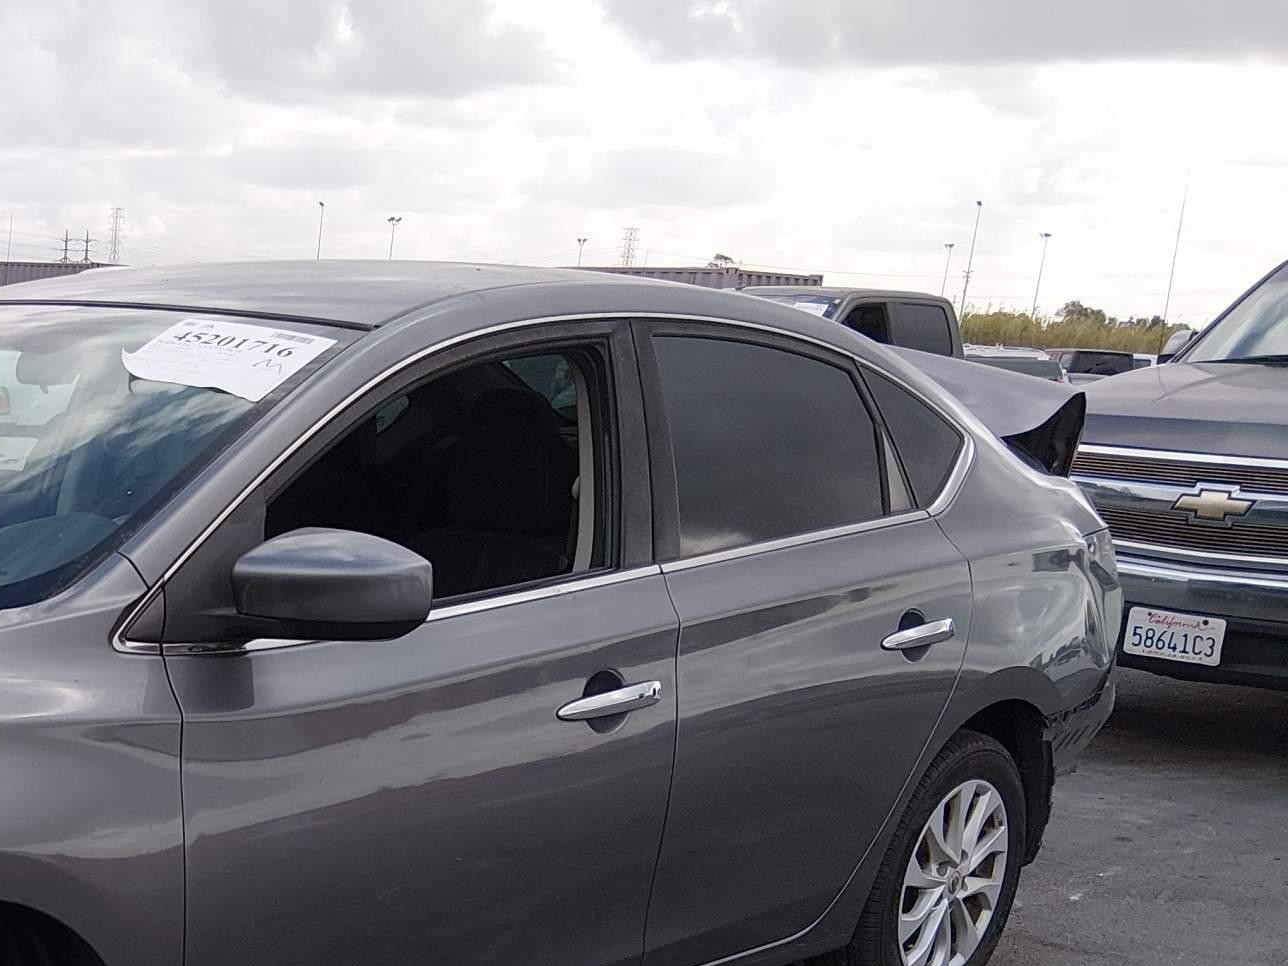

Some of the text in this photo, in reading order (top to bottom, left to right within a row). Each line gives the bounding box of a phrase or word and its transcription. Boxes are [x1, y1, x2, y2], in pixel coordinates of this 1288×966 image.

[173, 331, 296, 358] 45201716
[1148, 613, 1209, 631] California
[1132, 626, 1216, 658] 58641C3
